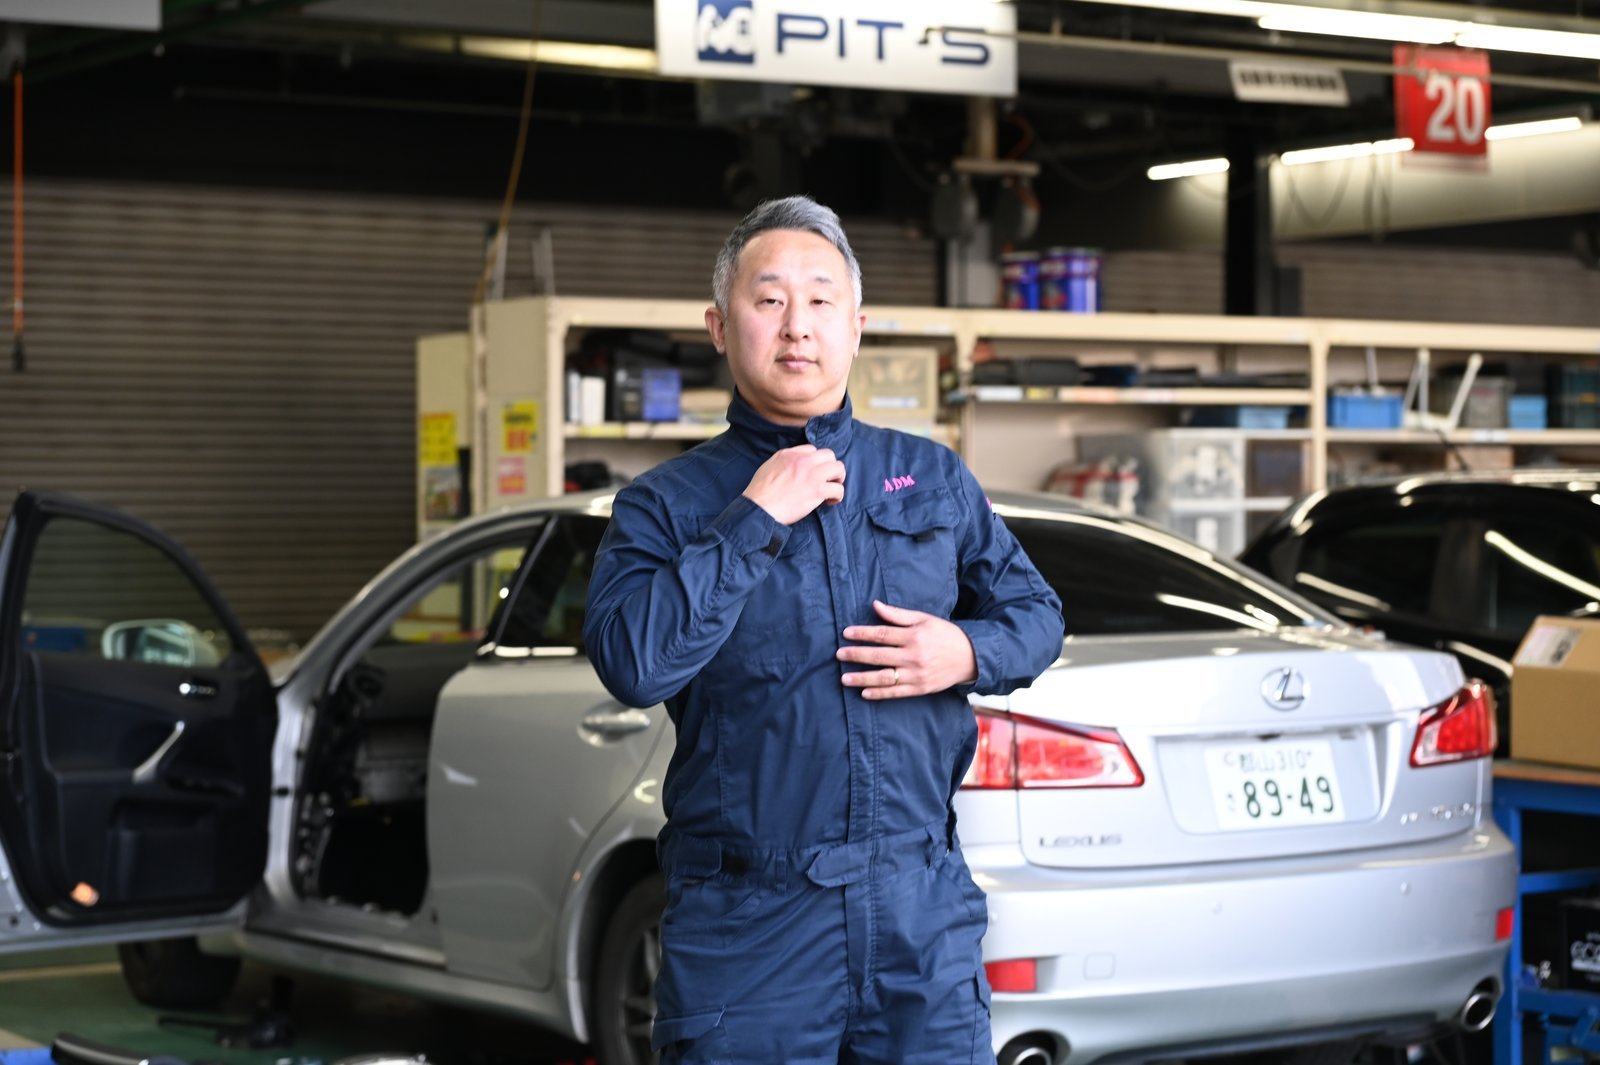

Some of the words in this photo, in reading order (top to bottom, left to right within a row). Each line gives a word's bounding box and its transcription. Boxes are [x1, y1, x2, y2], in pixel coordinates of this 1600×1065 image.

[1425, 73, 1486, 145] 20
[884, 474, 916, 492] ADM
[1242, 775, 1335, 819] 89-49
[1039, 834, 1123, 848] LEXUS
